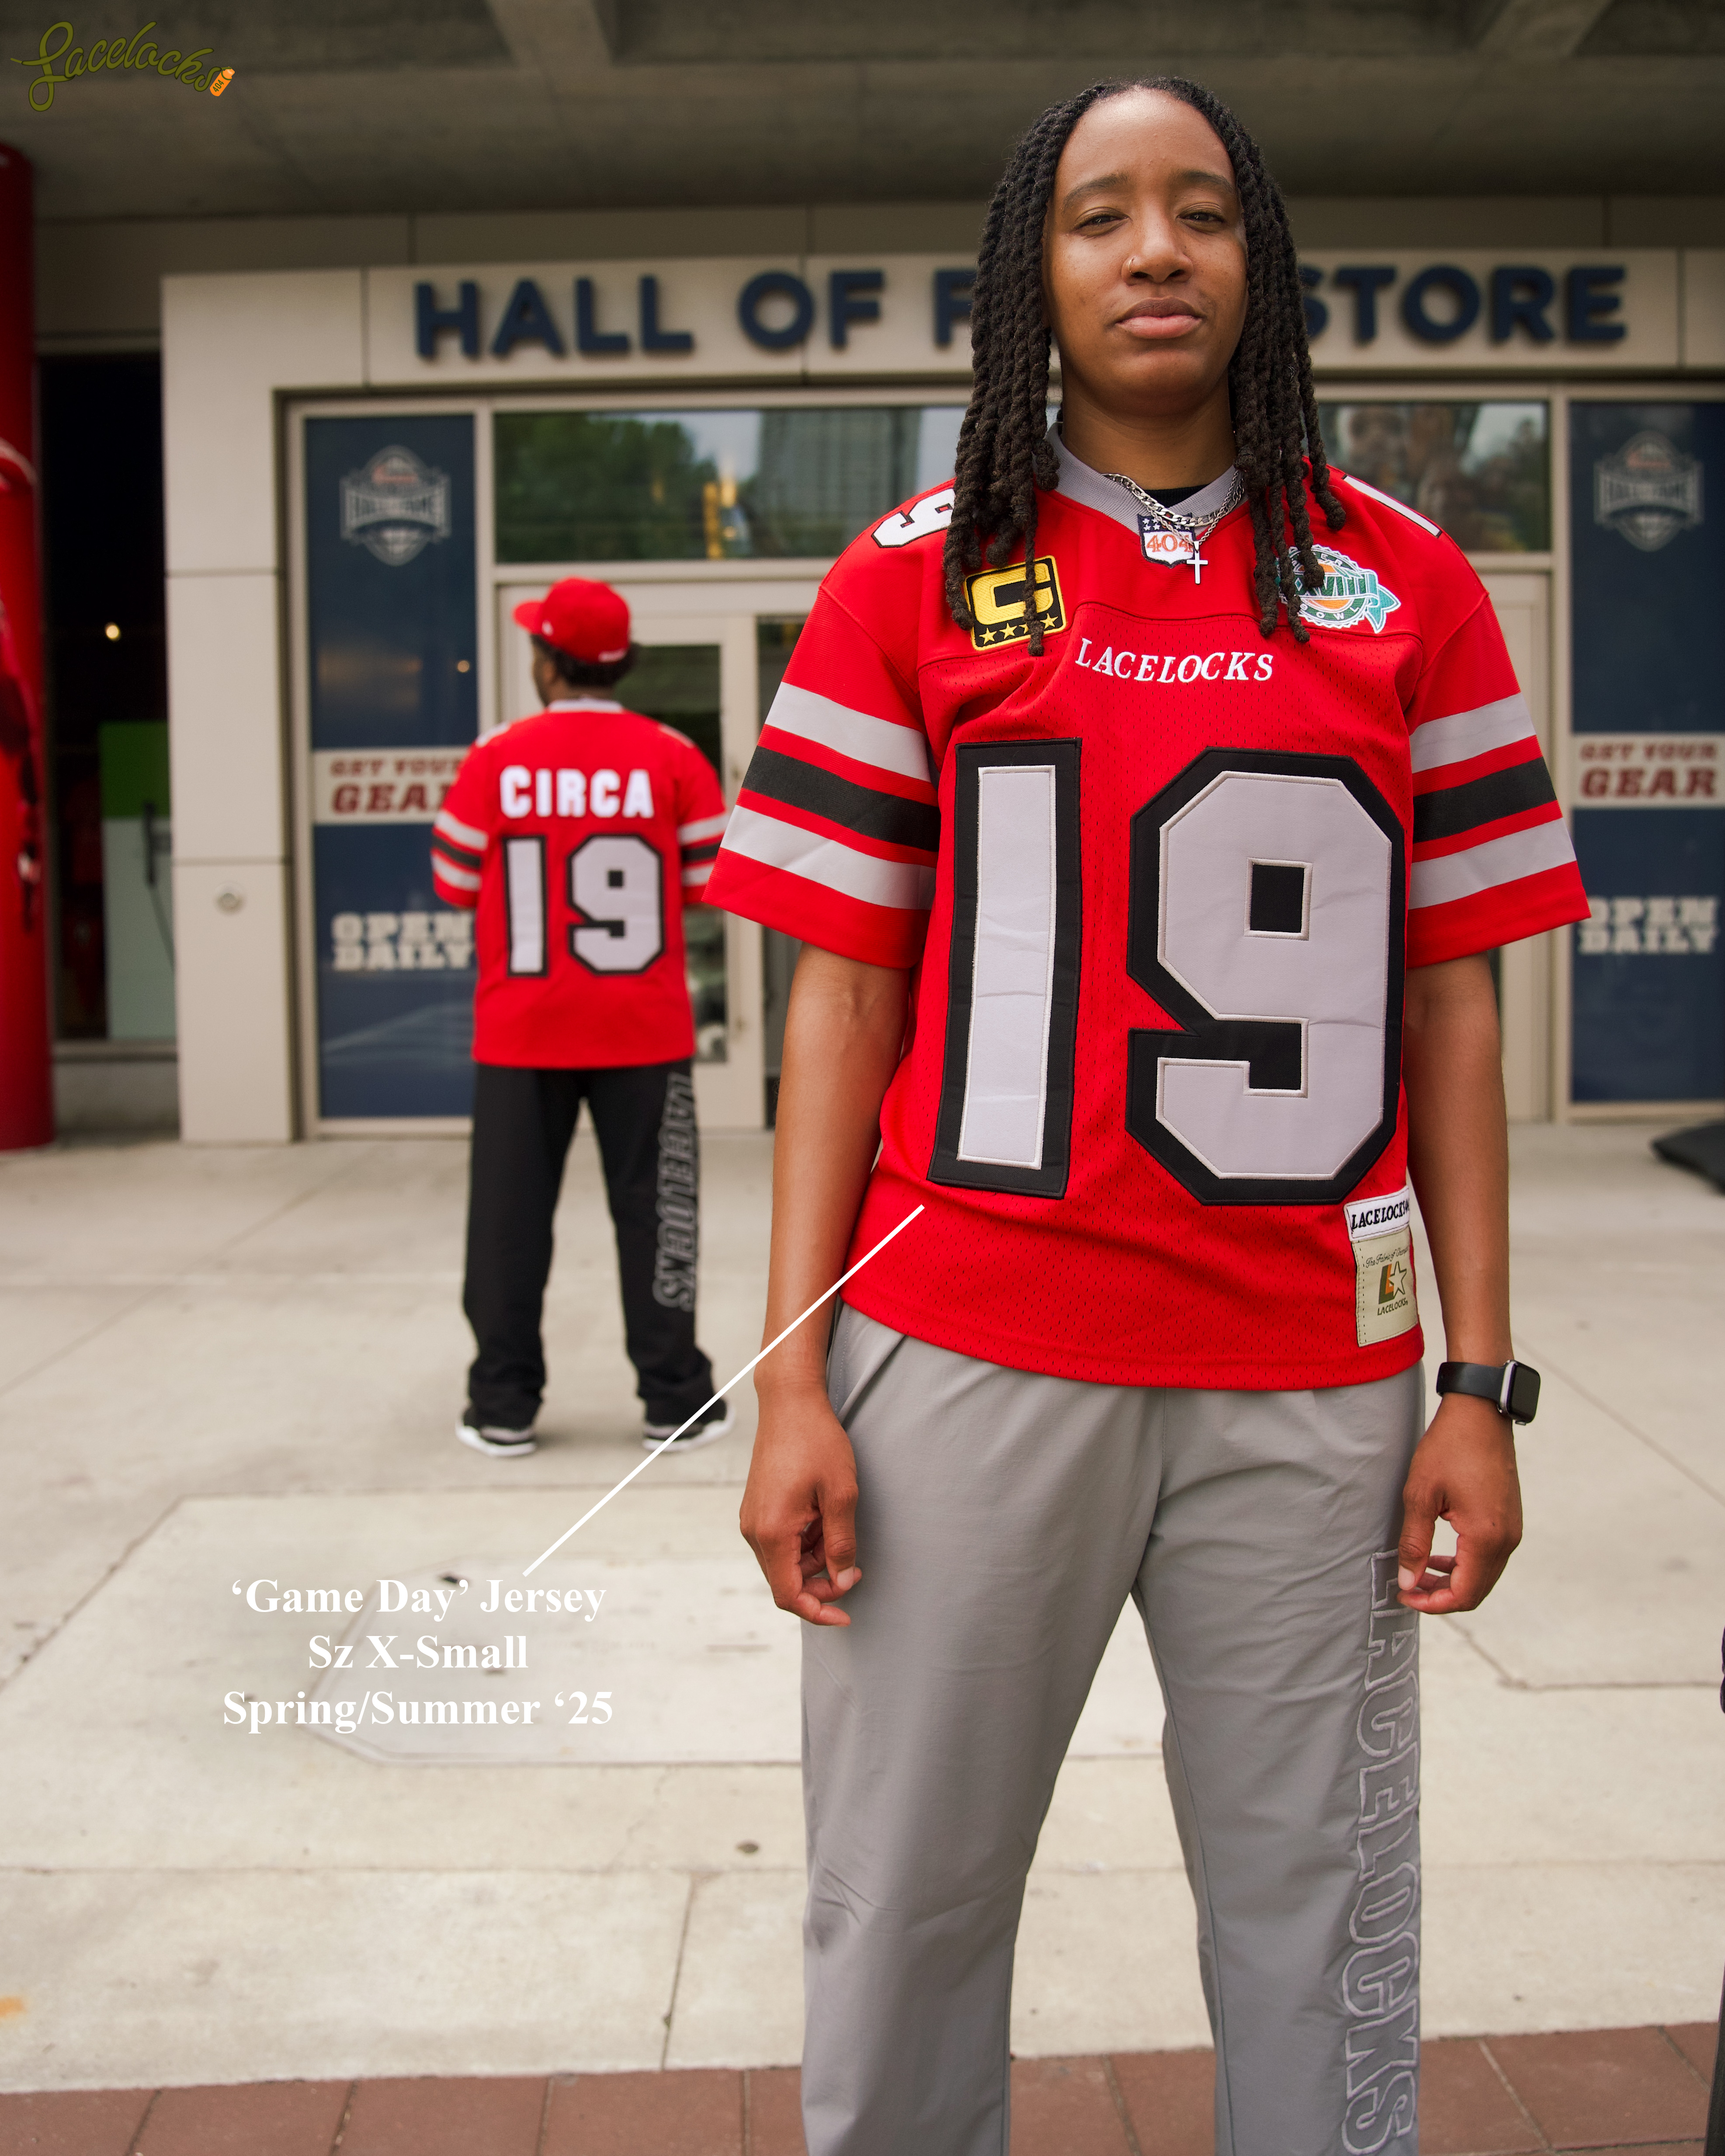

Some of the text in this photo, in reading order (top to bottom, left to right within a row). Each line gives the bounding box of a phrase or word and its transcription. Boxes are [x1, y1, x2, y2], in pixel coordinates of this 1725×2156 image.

[414, 275, 695, 360] HALL
[737, 270, 885, 352] OF
[1146, 534, 1193, 553] 404
[971, 562, 1053, 625] C
[1300, 603, 1360, 620] BOWL
[1075, 638, 1274, 683] LACELOCKS
[331, 782, 454, 814] GEA
[500, 765, 655, 819] CIRCA
[1579, 766, 1716, 798] GEAR
[503, 833, 665, 978] 19
[331, 910, 473, 942] OPEN
[1579, 925, 1718, 955] DAILY
[333, 942, 474, 971] DAILY
[927, 738, 1405, 1206] 19
[652, 1071, 697, 1311] LACELOCKS
[1366, 1257, 1375, 1268] The
[1341, 1549, 1419, 2156] LACELOCKS
